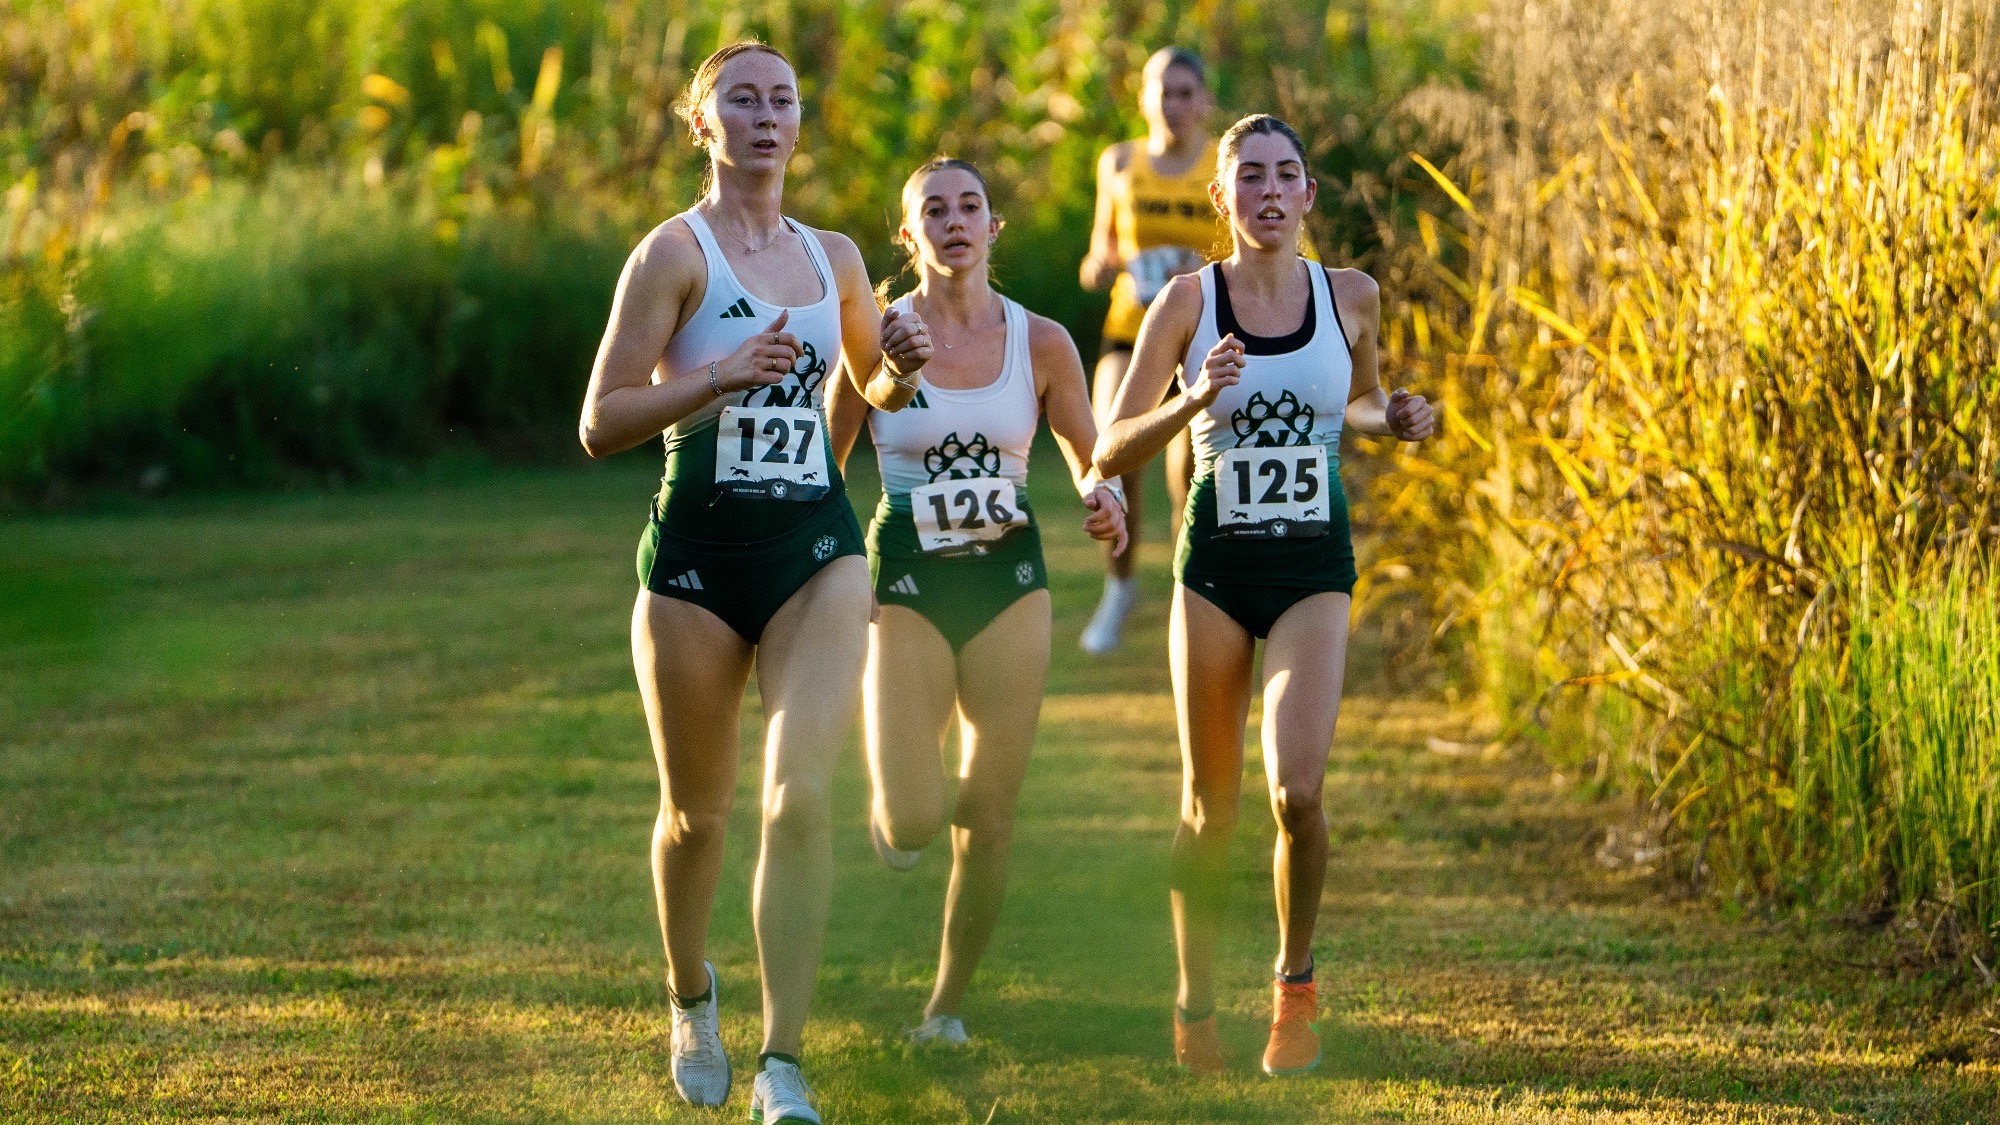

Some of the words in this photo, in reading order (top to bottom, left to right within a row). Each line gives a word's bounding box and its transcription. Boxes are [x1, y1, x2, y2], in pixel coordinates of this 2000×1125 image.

[737, 417, 816, 464] 127
[1232, 457, 1319, 505] 125
[928, 489, 1014, 531] 126
